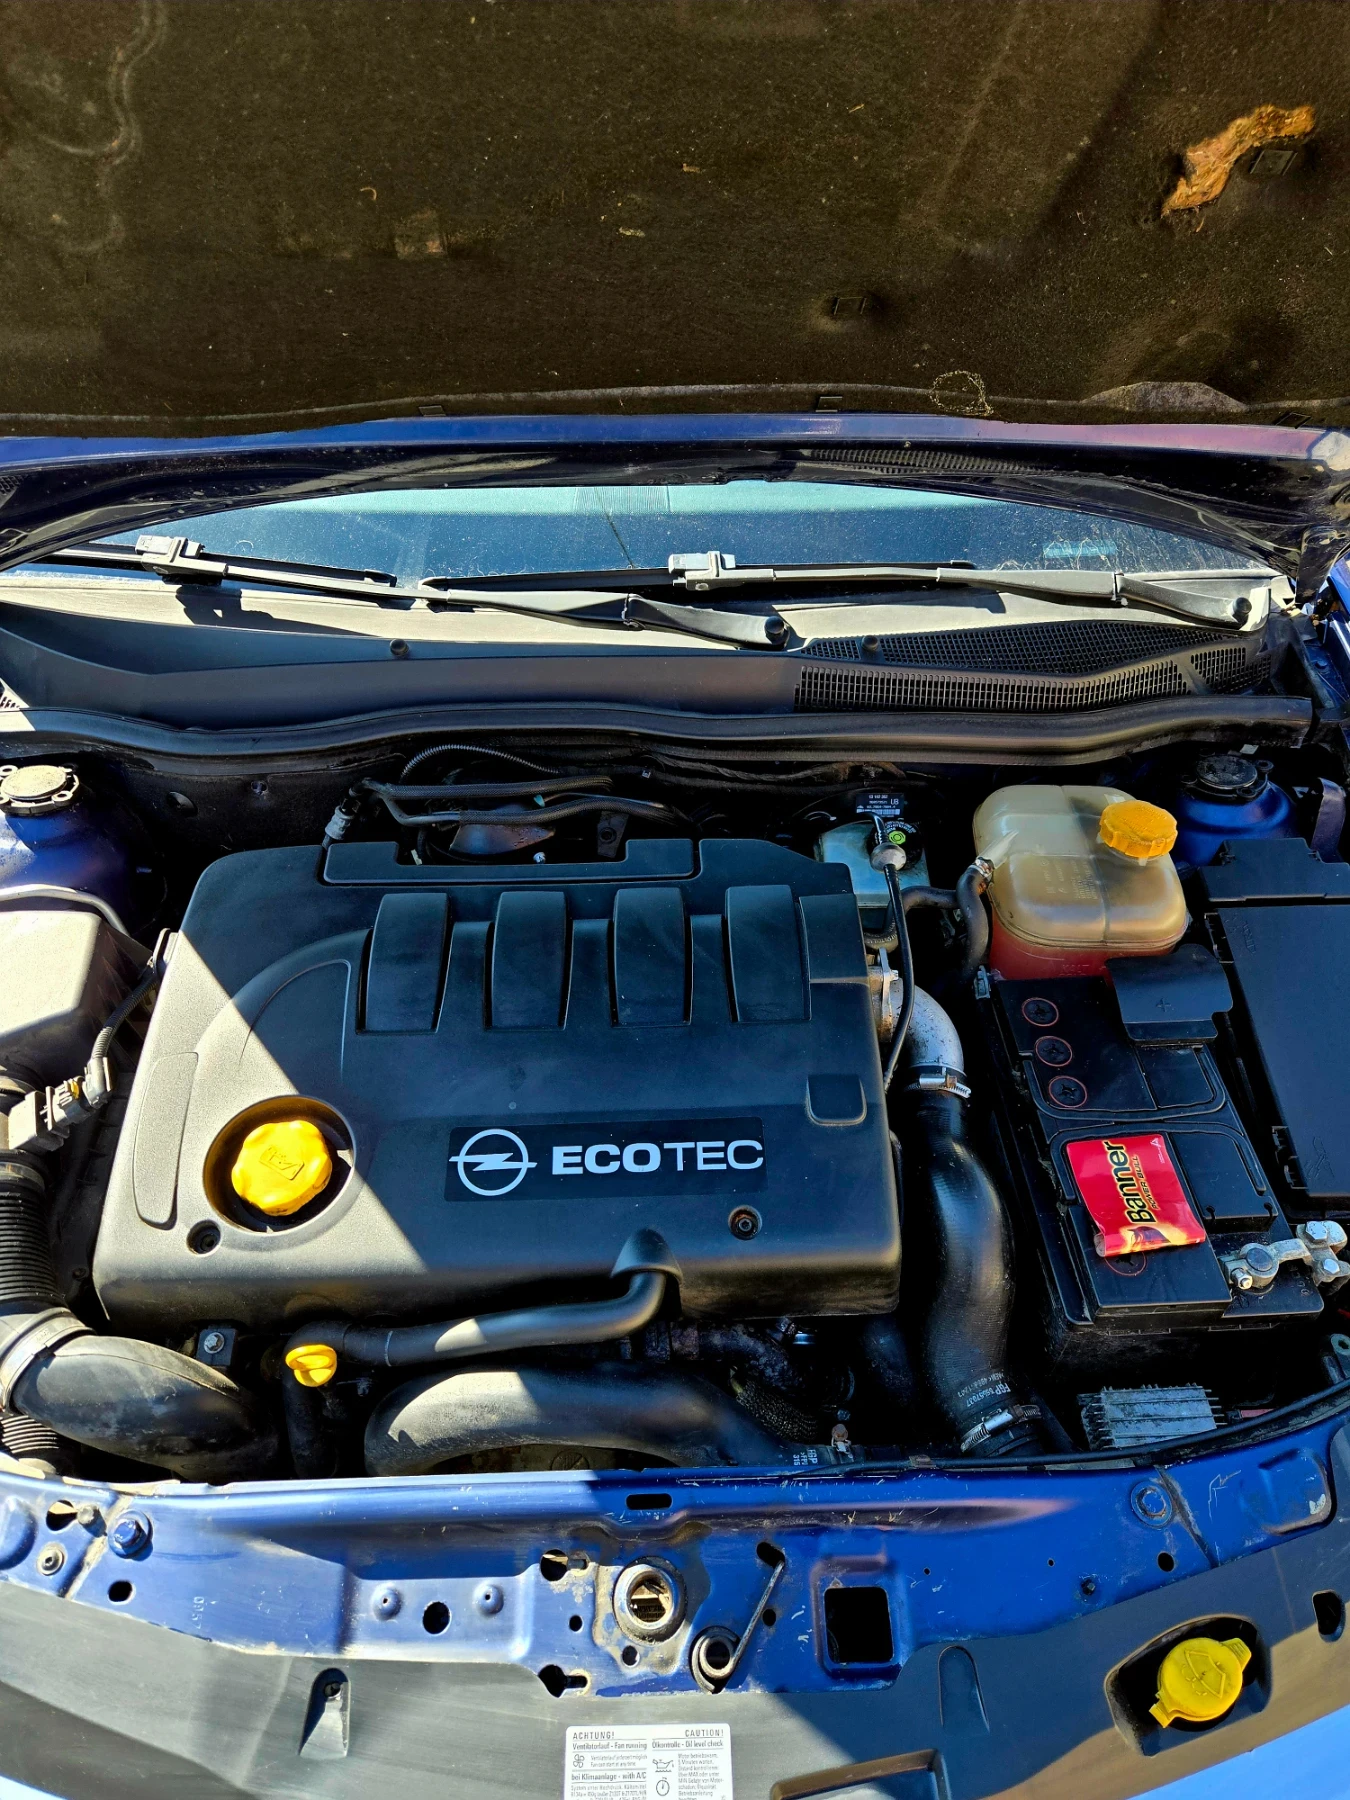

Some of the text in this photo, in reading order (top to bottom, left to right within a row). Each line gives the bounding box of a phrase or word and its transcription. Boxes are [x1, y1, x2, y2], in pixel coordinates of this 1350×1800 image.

[552, 1140, 764, 1175] ECOTEC
[1103, 1141, 1156, 1222] Banner
[1132, 1155, 1158, 1209] POWER BULL
[573, 1731, 615, 1740] ACHTUNG!
[685, 1729, 724, 1737] CAUTION!
[572, 1742, 610, 1750] Ventilatorlauf
[625, 1741, 647, 1750] running
[707, 1739, 723, 1747] check
[571, 1773, 580, 1781] bei
[581, 1773, 617, 1781] Klimaanlage
[622, 1772, 635, 1780] with
